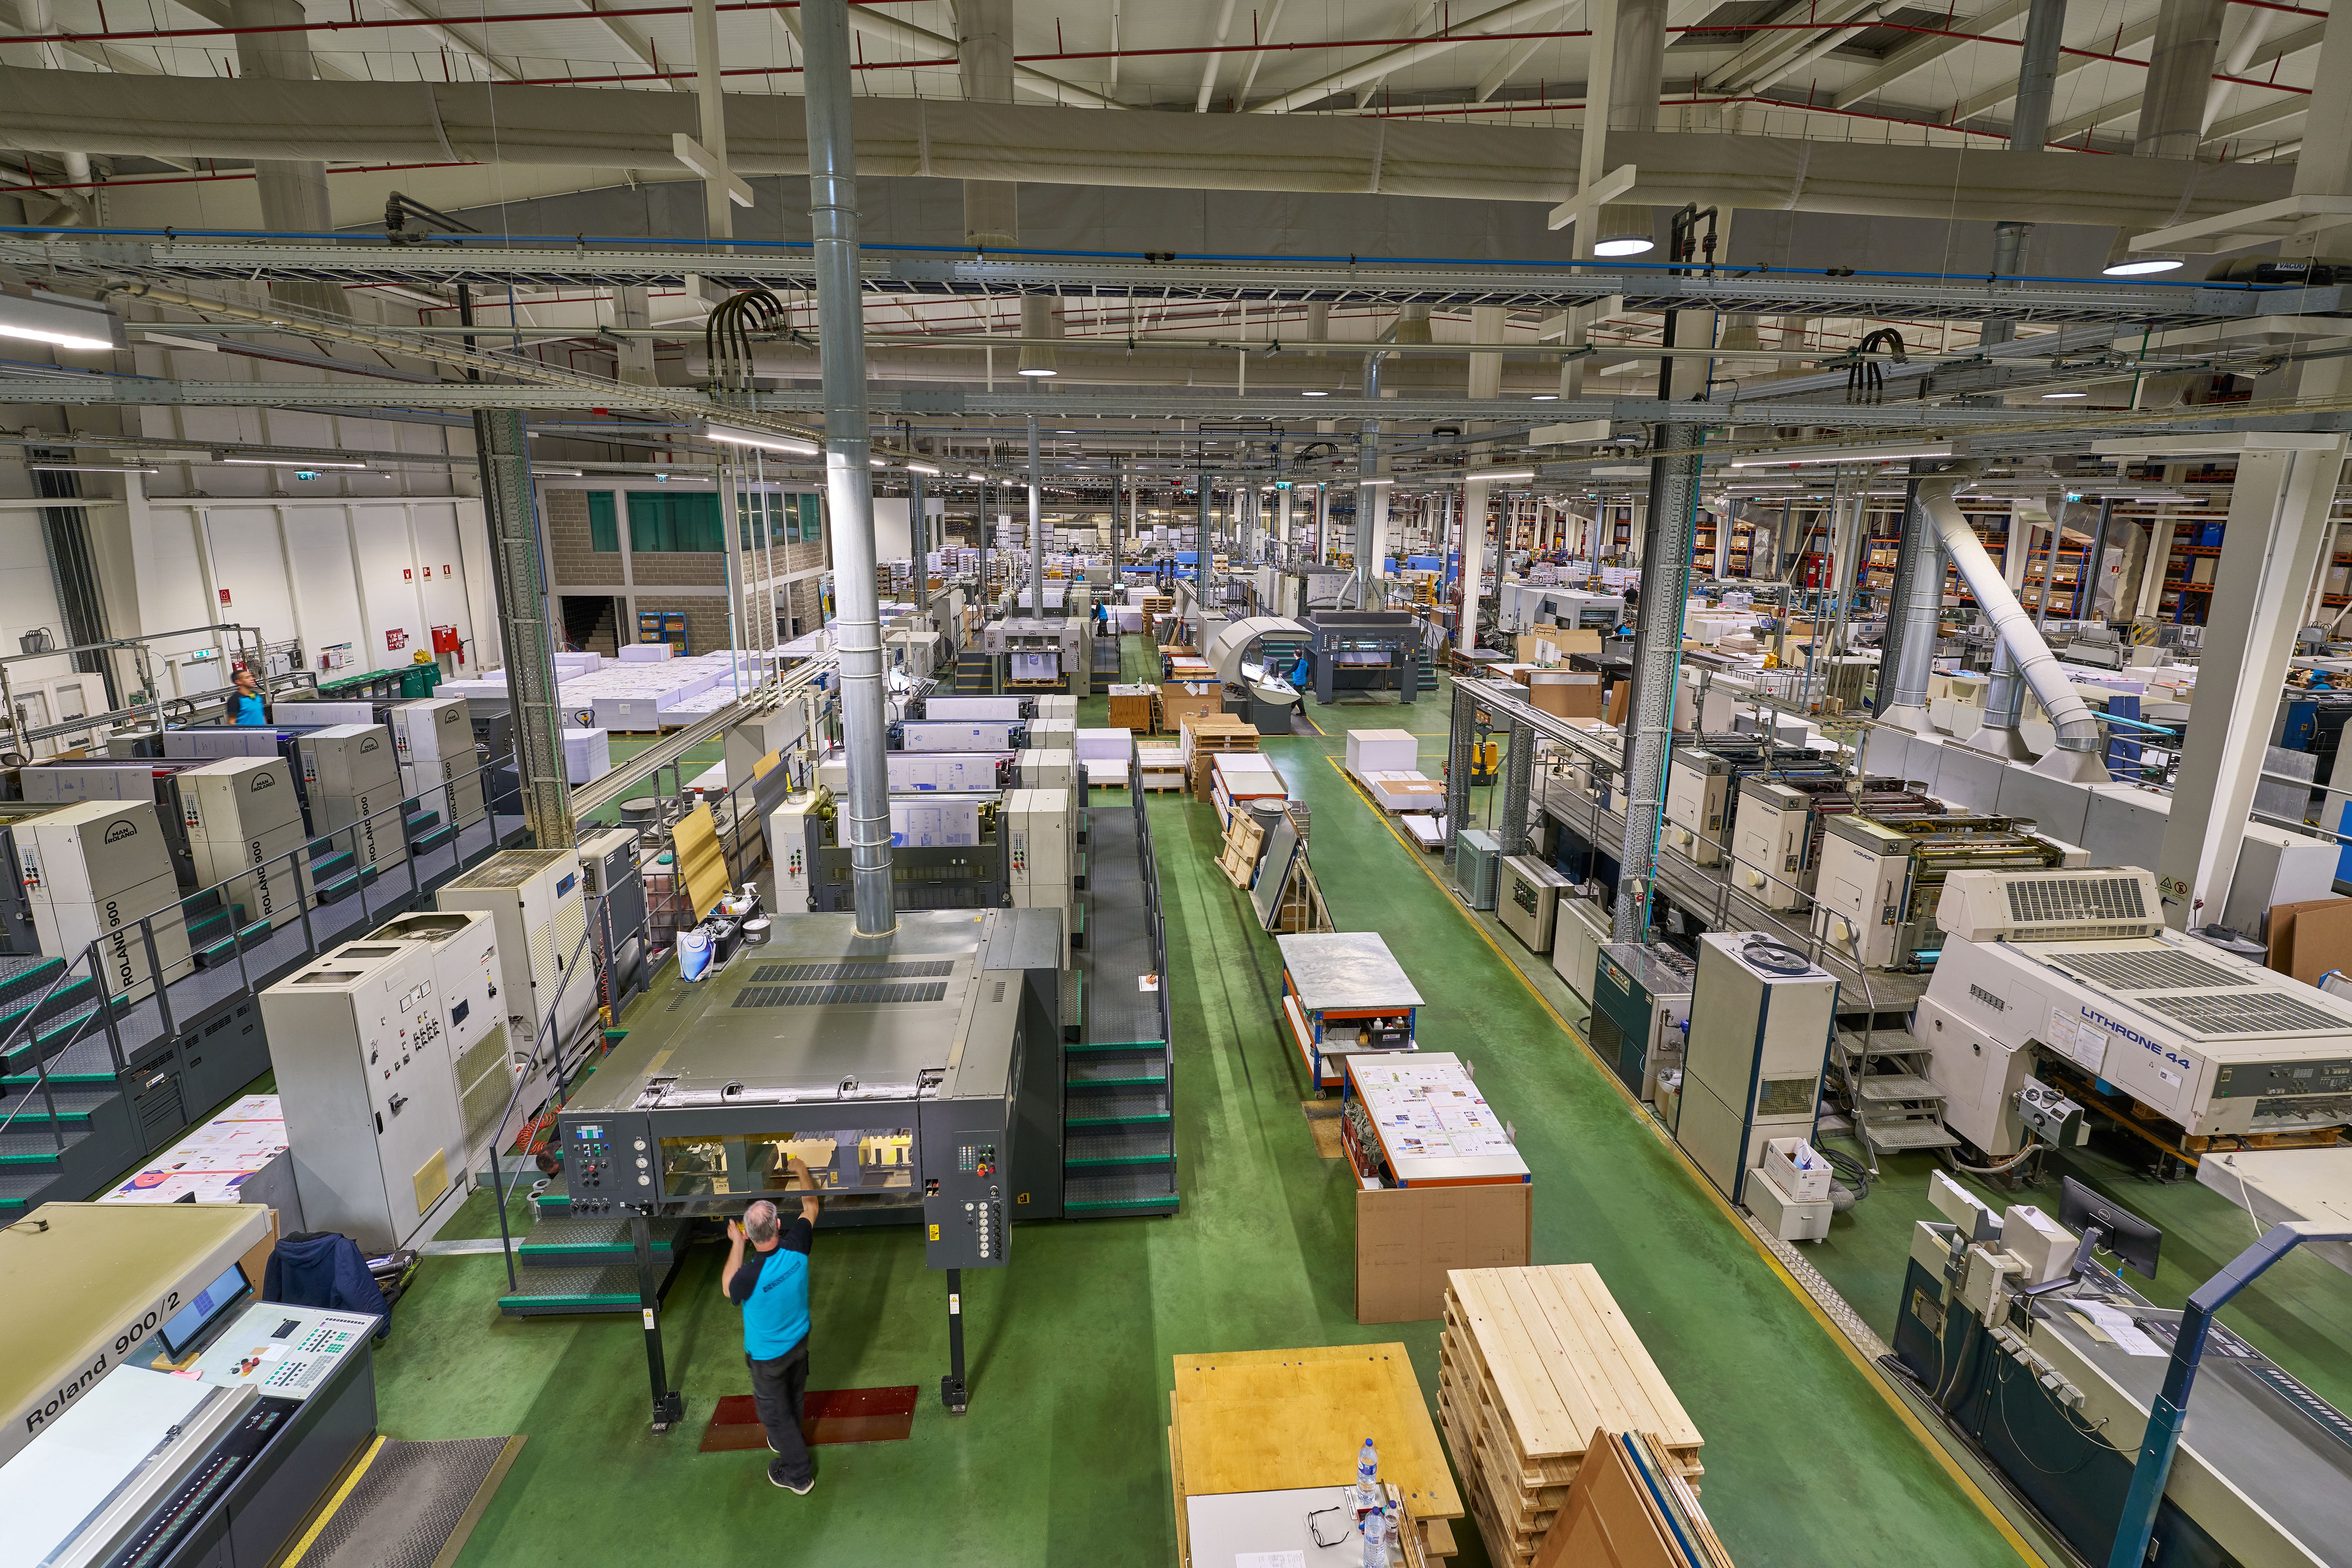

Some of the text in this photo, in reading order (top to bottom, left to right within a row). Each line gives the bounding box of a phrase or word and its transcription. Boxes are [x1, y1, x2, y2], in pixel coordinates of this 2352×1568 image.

[362, 746, 378, 754] ROLAND
[1690, 772, 1702, 781] KOMORI
[253, 782, 273, 793] ROLAND
[448, 782, 458, 821] ROLAND
[1762, 806, 1778, 817] KOMORI
[112, 828, 128, 837] MAN
[361, 796, 376, 861] ROLAND 900
[107, 830, 135, 844] ROLAND
[1853, 849, 1875, 862] KOMORI
[252, 841, 272, 915] ROLAND 900
[106, 901, 134, 987] ROLAND 900
[2080, 1016, 2119, 1039] KOMORI CORPORATION
[2081, 1006, 2163, 1055] LITHRONE
[2165, 1053, 2190, 1070] 44
[1786, 1163, 1795, 1173] Powder
[1777, 1180, 1792, 1197] FlintGroup
[26, 1291, 181, 1434] Roland 900/2
